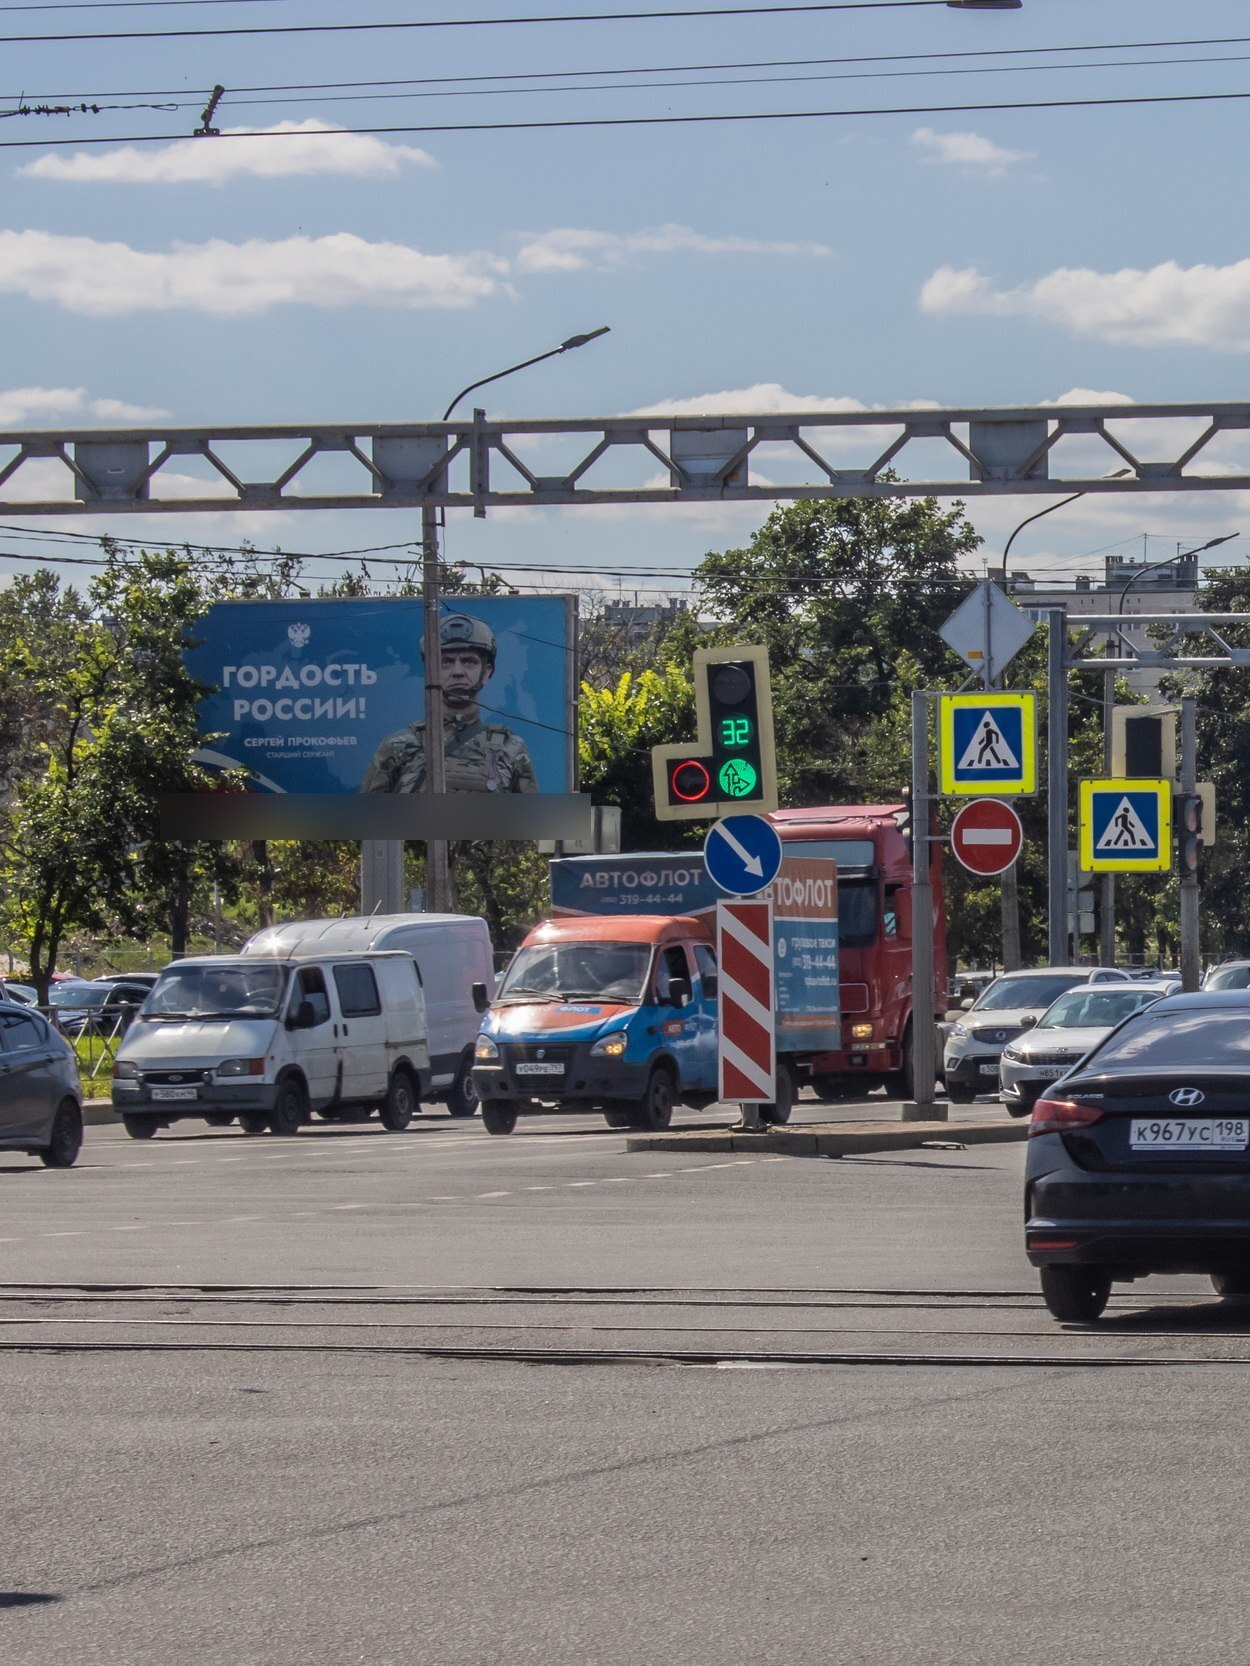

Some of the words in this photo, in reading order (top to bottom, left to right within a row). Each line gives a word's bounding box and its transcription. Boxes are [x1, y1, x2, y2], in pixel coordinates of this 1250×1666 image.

[223, 664, 377, 690] ГОРДОСТЬ
[234, 697, 366, 721] РОССИИ!
[244, 735, 284, 747] СЕРГЕЙ
[288, 736, 357, 747] ПРОКОФЬЕВ
[722, 719, 748, 745] 32
[266, 750, 300, 759] СТАРШИЙ
[302, 750, 335, 758] СЕРЖАНТ
[580, 869, 702, 888] АВТОФЛОТ
[619, 893, 683, 905] 319-44-44
[757, 877, 833, 908] ТОФЛОТ
[1137, 1122, 1211, 1141] К967УС
[1215, 1121, 1244, 1136] 198
